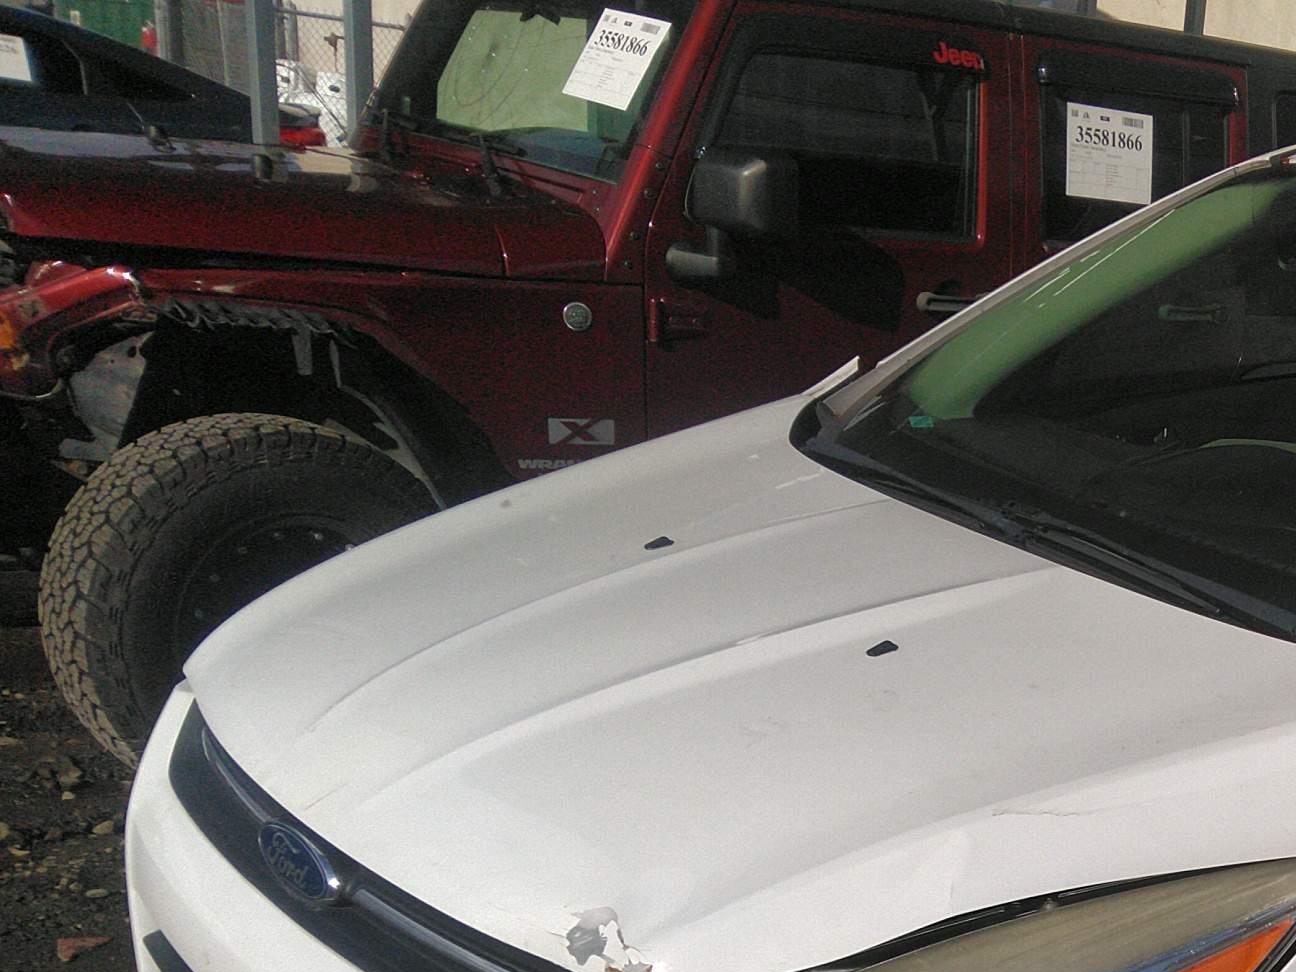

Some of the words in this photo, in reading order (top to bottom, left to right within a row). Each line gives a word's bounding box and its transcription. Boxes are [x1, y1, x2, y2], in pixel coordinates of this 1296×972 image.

[594, 29, 650, 56] 35581866
[931, 41, 985, 70] Jeep
[1075, 125, 1143, 151] 35581866
[267, 832, 311, 888] Ford
